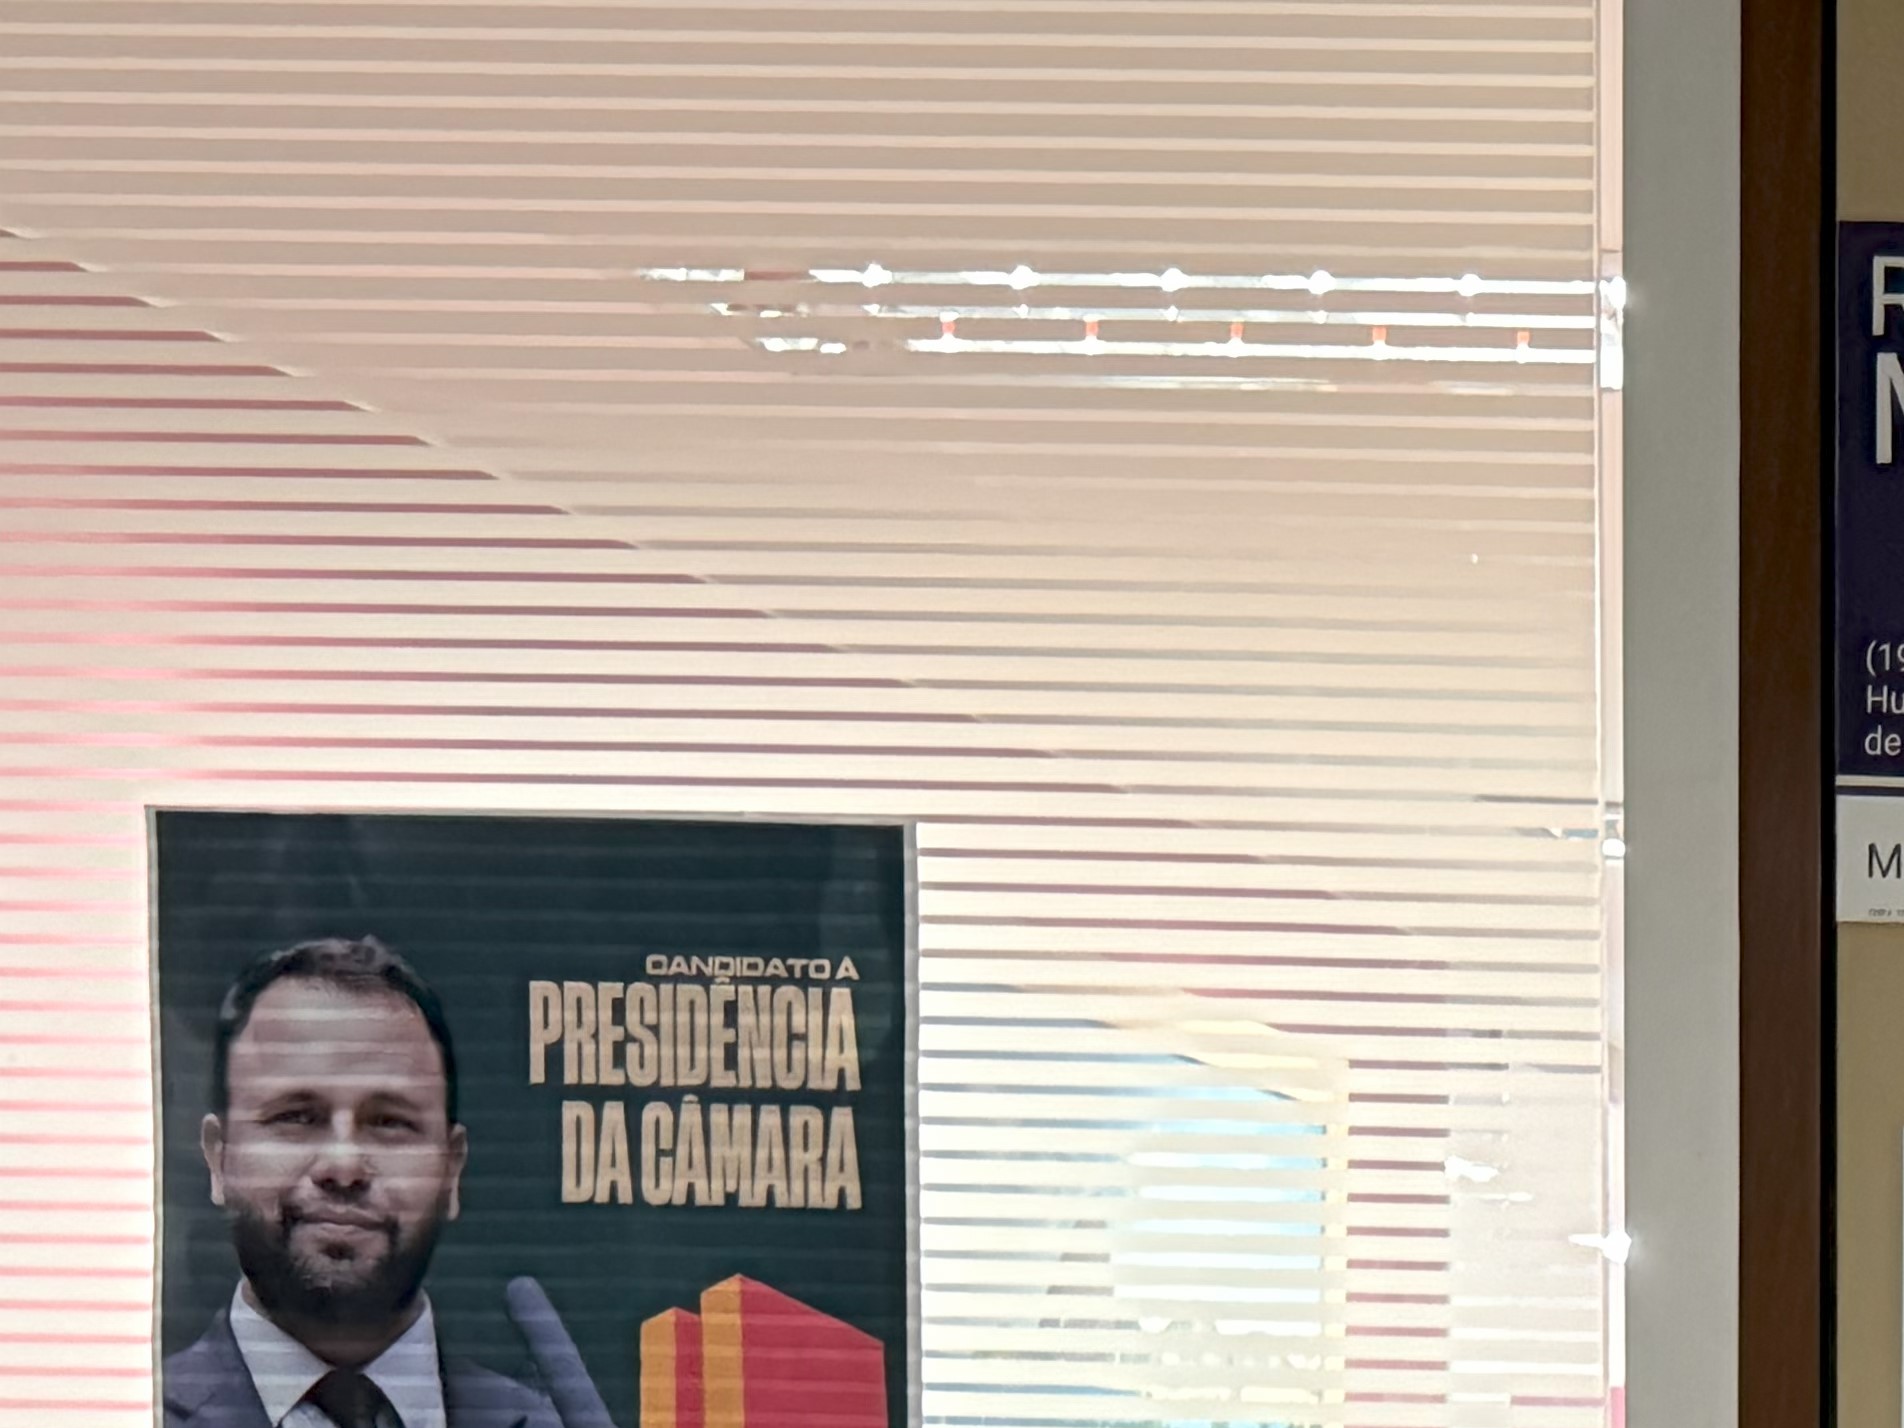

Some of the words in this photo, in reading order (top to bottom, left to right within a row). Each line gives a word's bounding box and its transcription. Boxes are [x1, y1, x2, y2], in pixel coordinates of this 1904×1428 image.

[1864, 726, 1901, 757] de
[646, 954, 831, 979] CANDIDATO
[529, 977, 862, 1091] PRESIDÊNCIA
[562, 1100, 633, 1204] DA
[641, 1094, 862, 1209] CÂMARA
